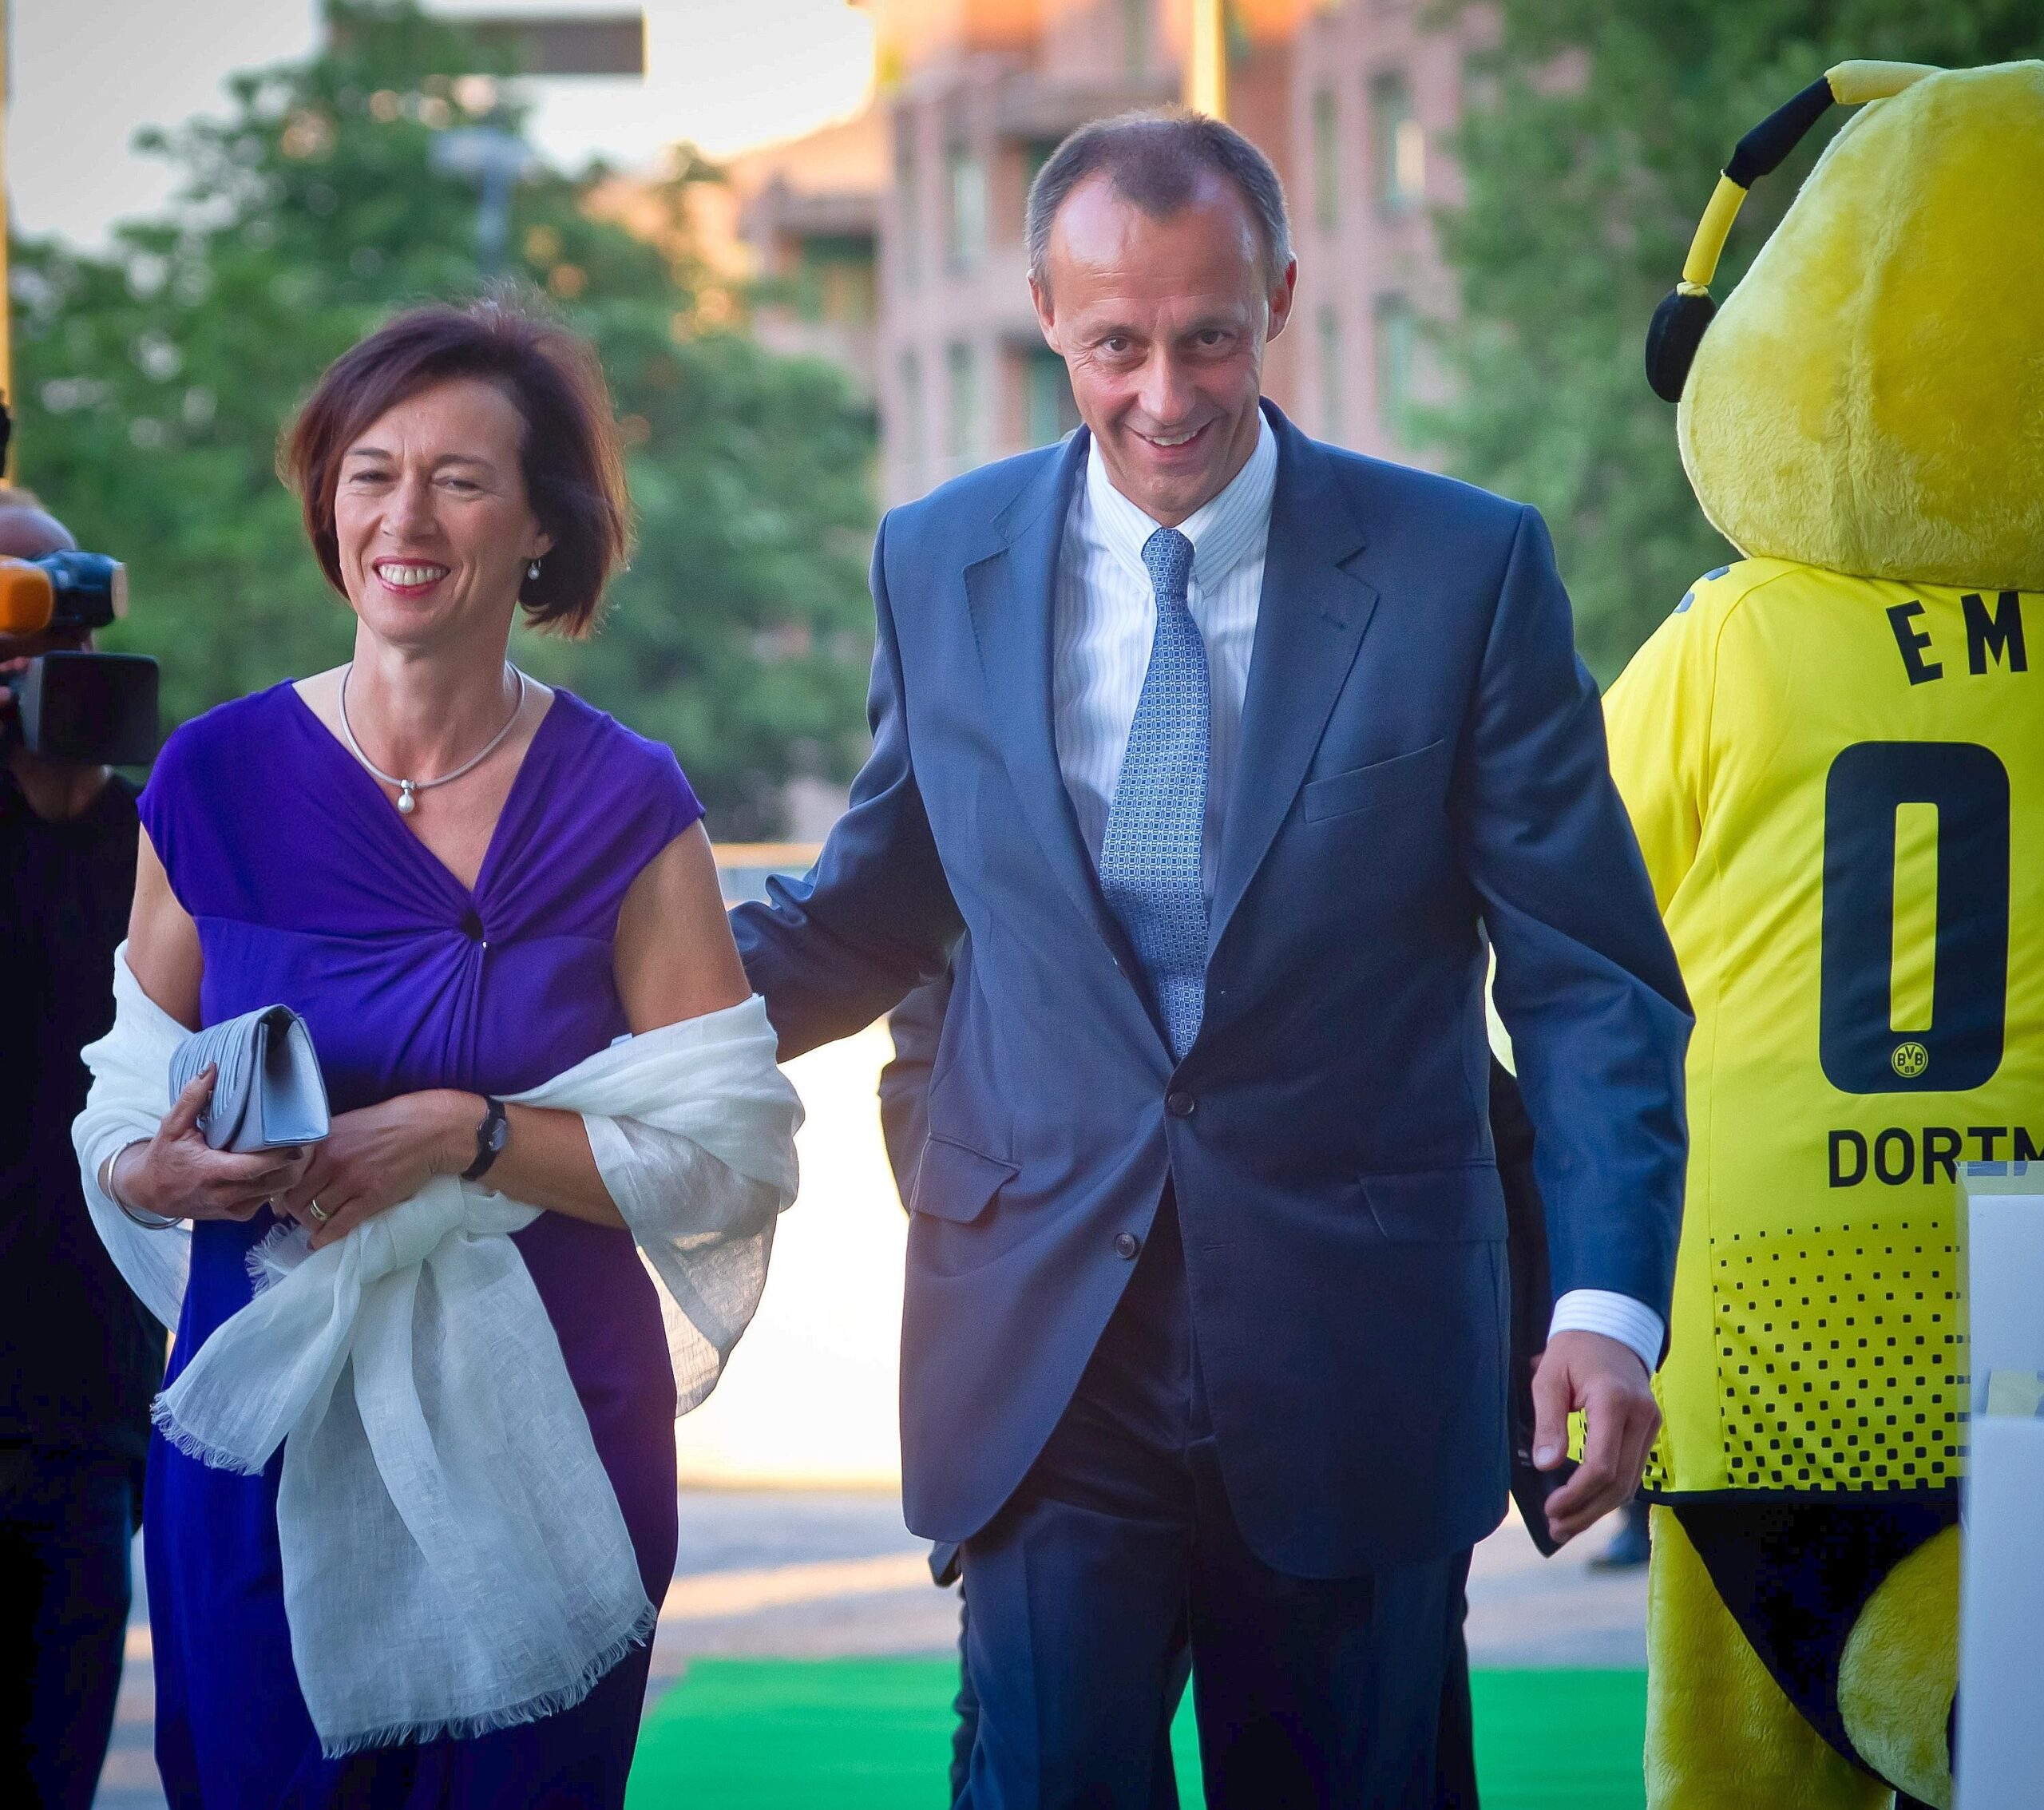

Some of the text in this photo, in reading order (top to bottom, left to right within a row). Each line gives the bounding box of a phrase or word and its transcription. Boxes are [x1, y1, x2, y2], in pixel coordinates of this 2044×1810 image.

[1885, 591, 2028, 686] EM
[1819, 740, 2010, 1094] 0
[1897, 1046, 1923, 1066] BVB
